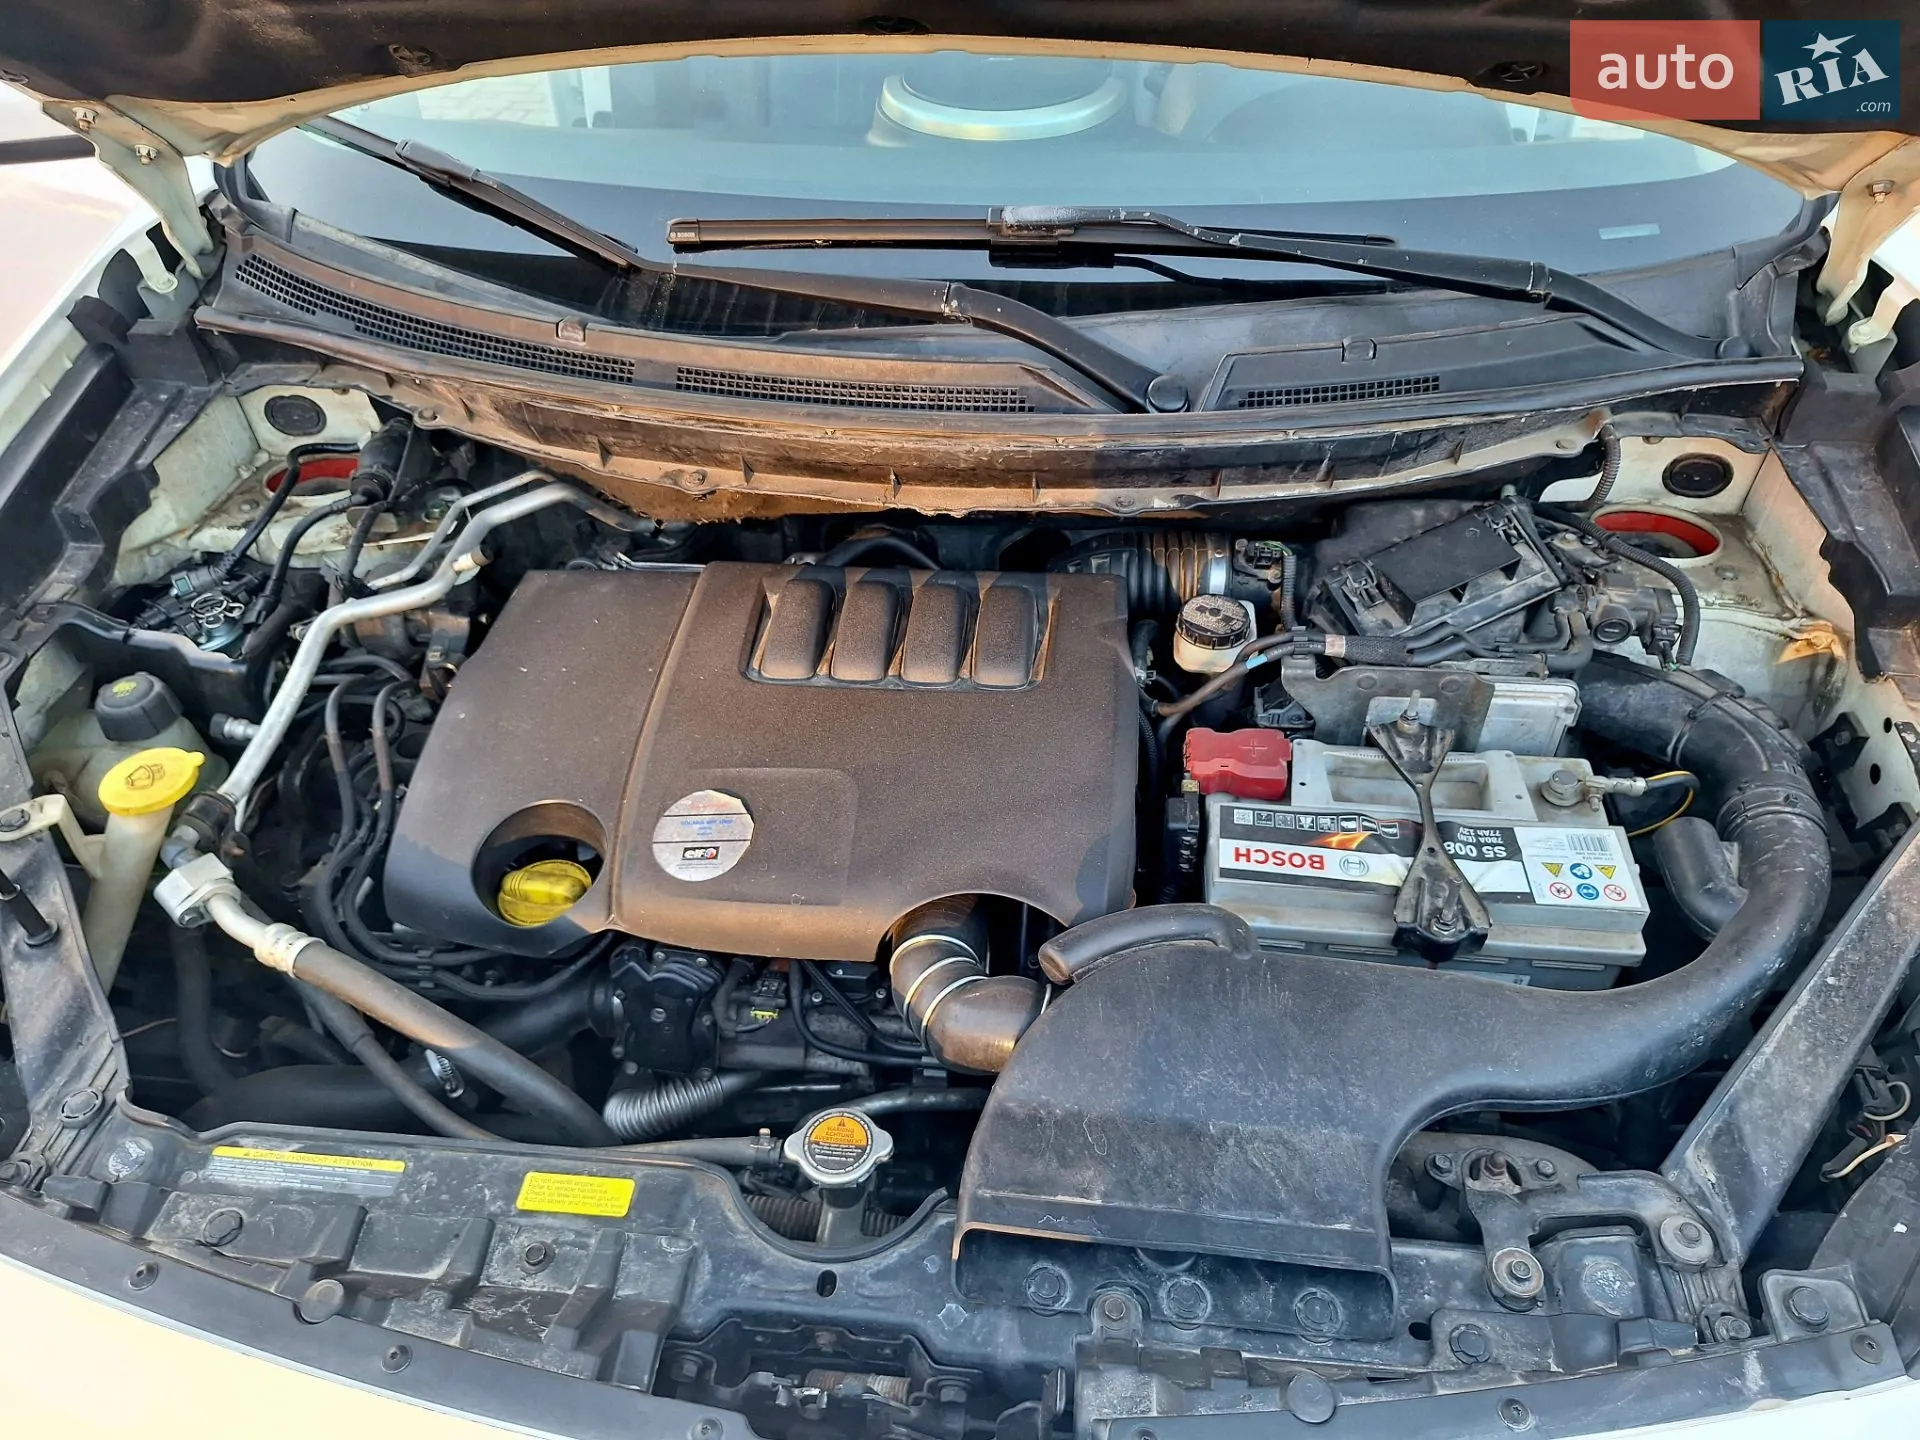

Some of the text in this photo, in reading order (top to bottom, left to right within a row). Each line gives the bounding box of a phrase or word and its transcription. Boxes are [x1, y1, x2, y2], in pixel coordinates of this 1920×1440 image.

[1476, 829, 1502, 837] 77Ah
[1478, 836, 1504, 844] 780A
[1443, 841, 1507, 858] S5 008
[1234, 847, 1325, 870] BOSCH
